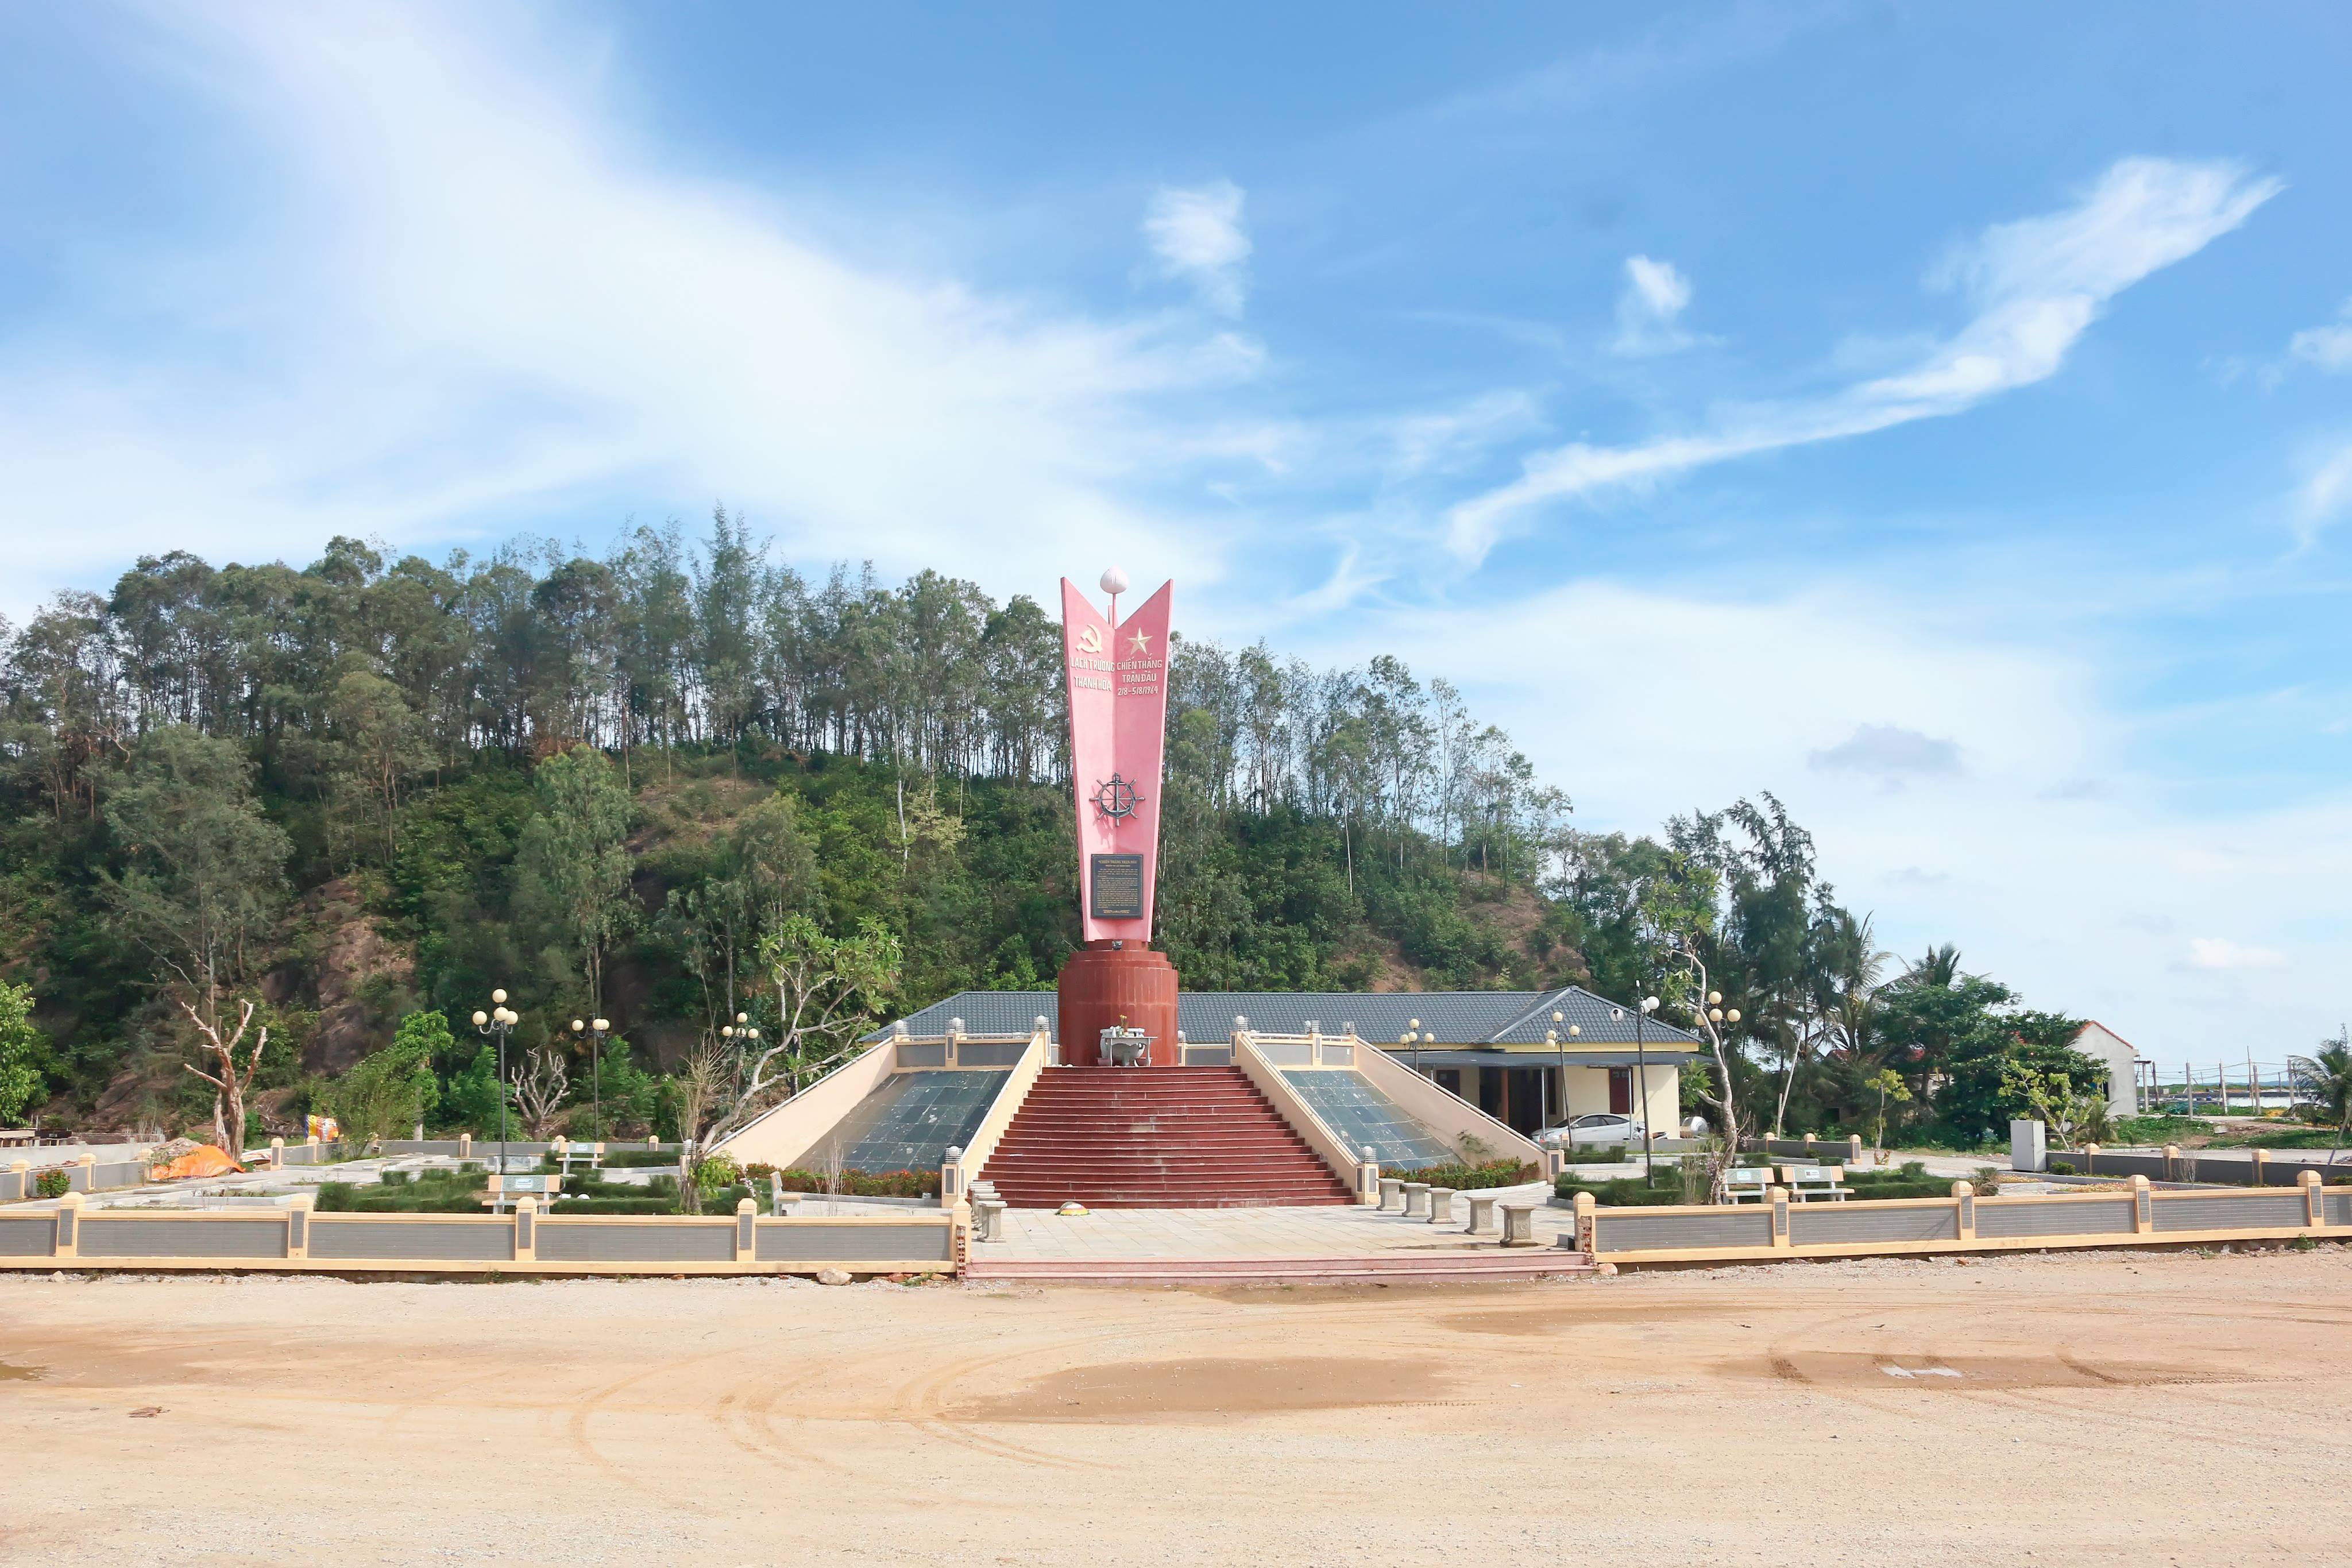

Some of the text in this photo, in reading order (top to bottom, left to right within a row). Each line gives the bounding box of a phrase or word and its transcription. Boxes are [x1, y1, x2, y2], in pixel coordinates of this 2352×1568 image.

[1071, 657, 1087, 670] LẠCH
[1117, 653, 1163, 670] CHIẾN THẮNG
[1122, 670, 1157, 684] TRẬN ĐẦU
[1074, 677, 1112, 692] THANH HÓA
